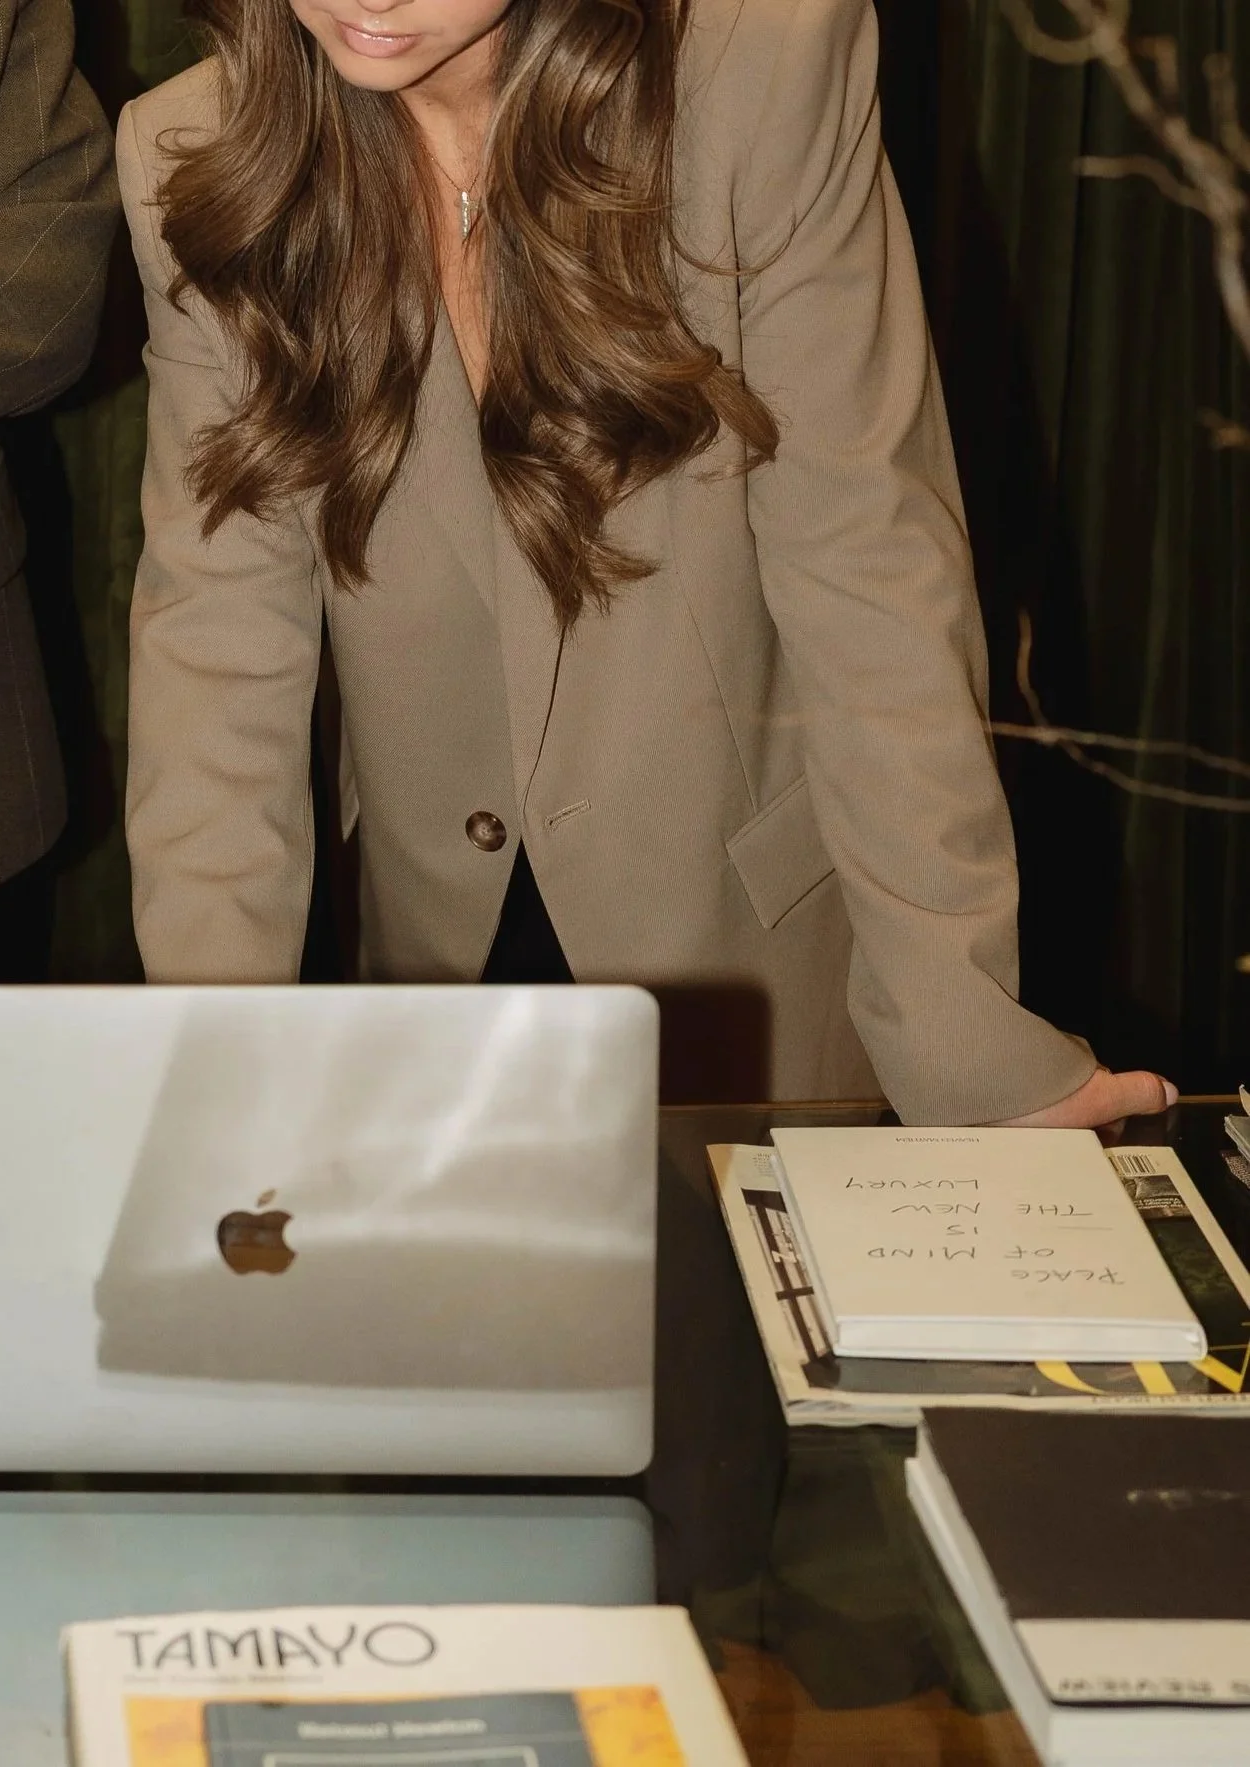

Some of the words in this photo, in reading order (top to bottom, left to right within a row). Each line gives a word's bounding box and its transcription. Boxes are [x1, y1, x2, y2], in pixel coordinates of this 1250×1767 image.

[845, 1176, 979, 1190] LUXURY
[891, 1202, 980, 1214] NEW
[1015, 1204, 1094, 1216] THE
[946, 1224, 979, 1236] IS
[867, 1246, 975, 1259] MIND
[1004, 1245, 1055, 1259] OF
[115, 1621, 438, 1669] TAMAYO
